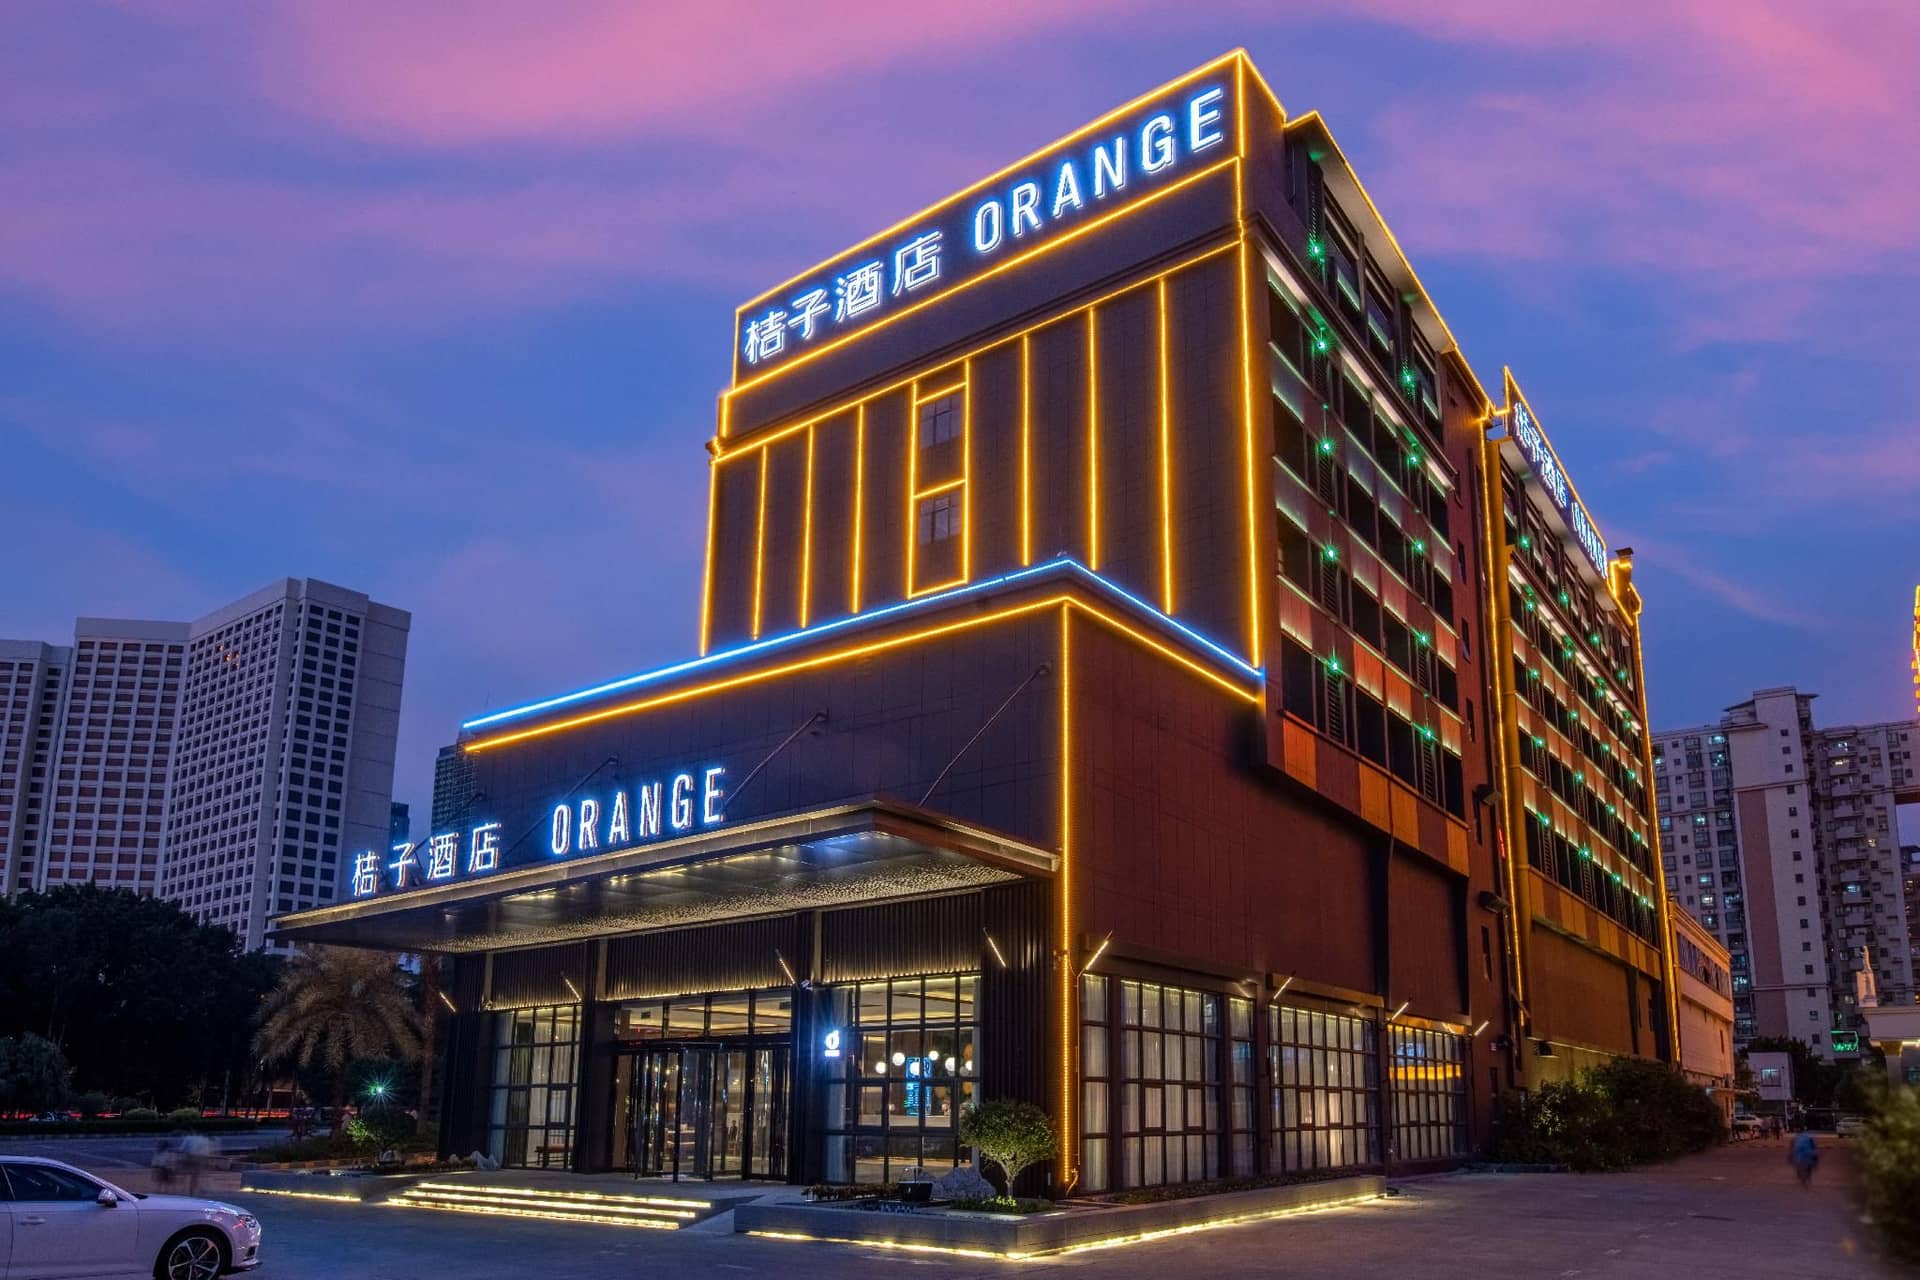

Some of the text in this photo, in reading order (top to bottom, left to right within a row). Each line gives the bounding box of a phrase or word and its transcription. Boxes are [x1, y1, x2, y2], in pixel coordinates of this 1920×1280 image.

[744, 87, 1224, 364] 桔子酒店 ORANGE
[351, 767, 726, 897] 桔子酒店 ORANGE
